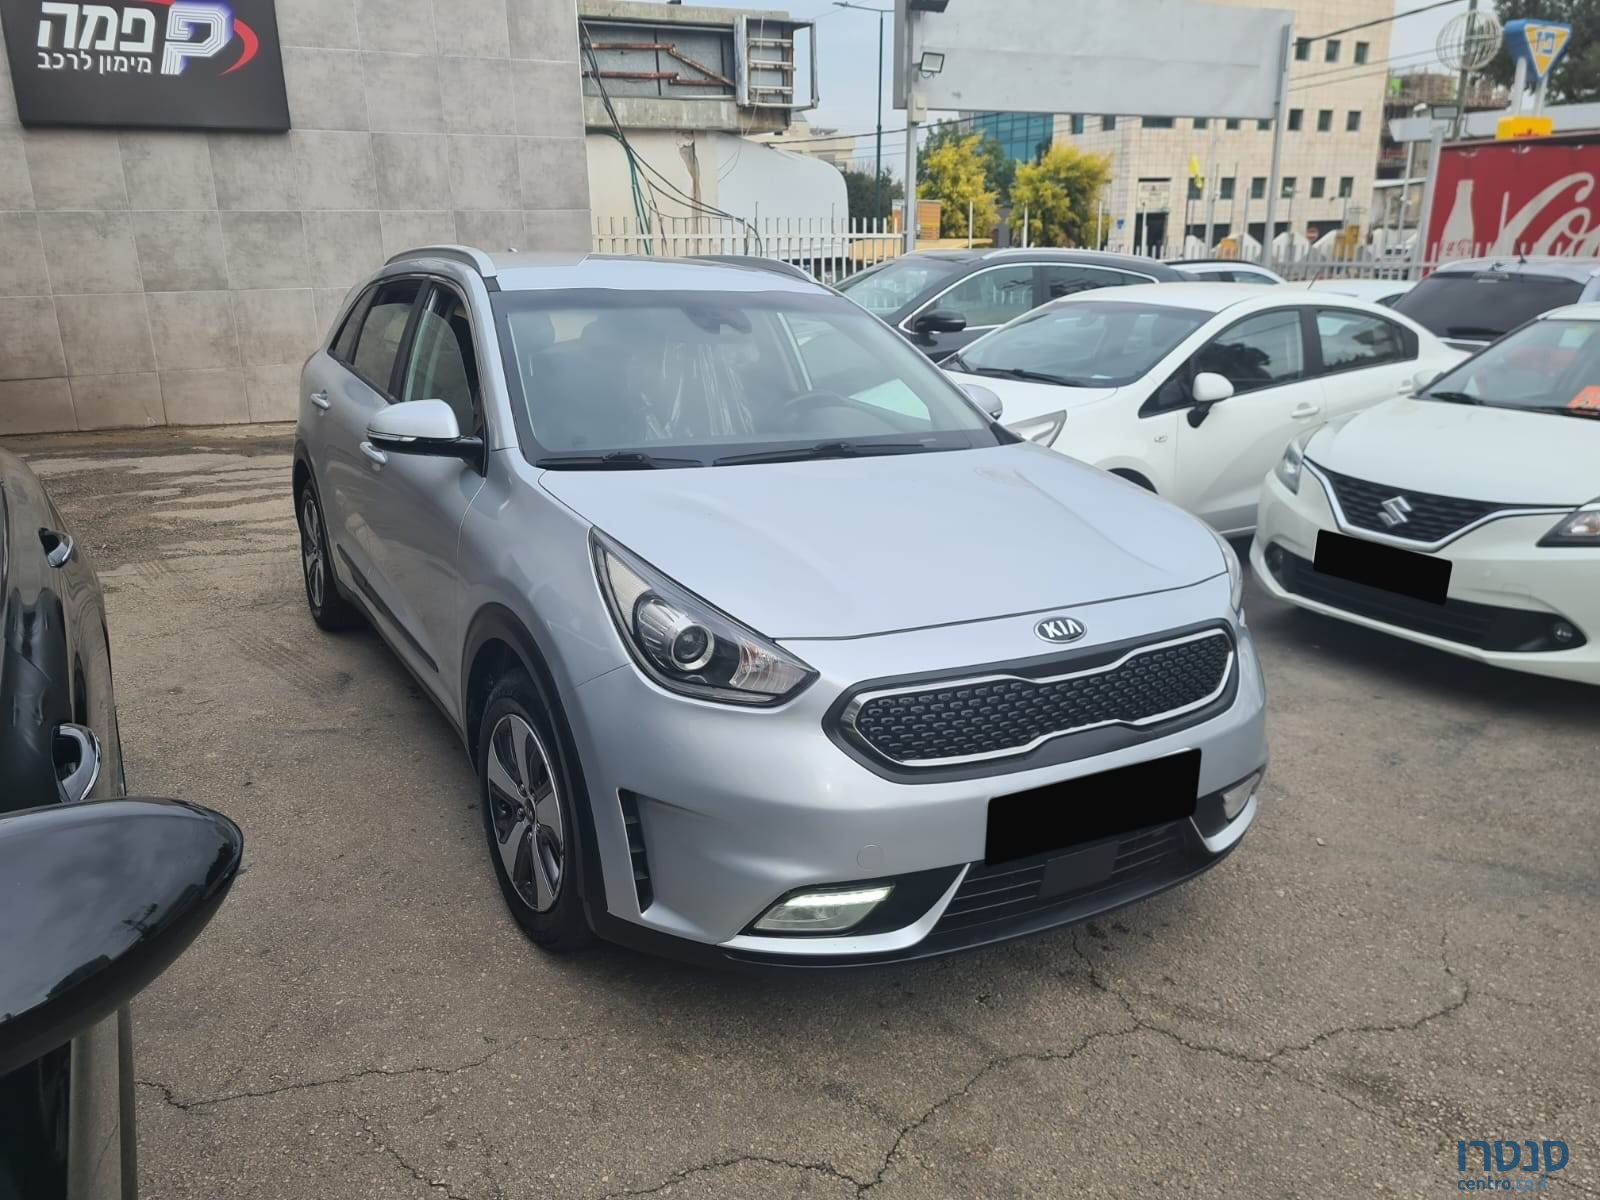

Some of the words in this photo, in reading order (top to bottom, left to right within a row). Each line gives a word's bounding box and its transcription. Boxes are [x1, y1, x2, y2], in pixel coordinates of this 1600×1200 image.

[37, 2, 156, 52] פמה
[37, 51, 92, 69] לרכב
[99, 55, 152, 74] מימון
[1040, 618, 1083, 639] KIA
